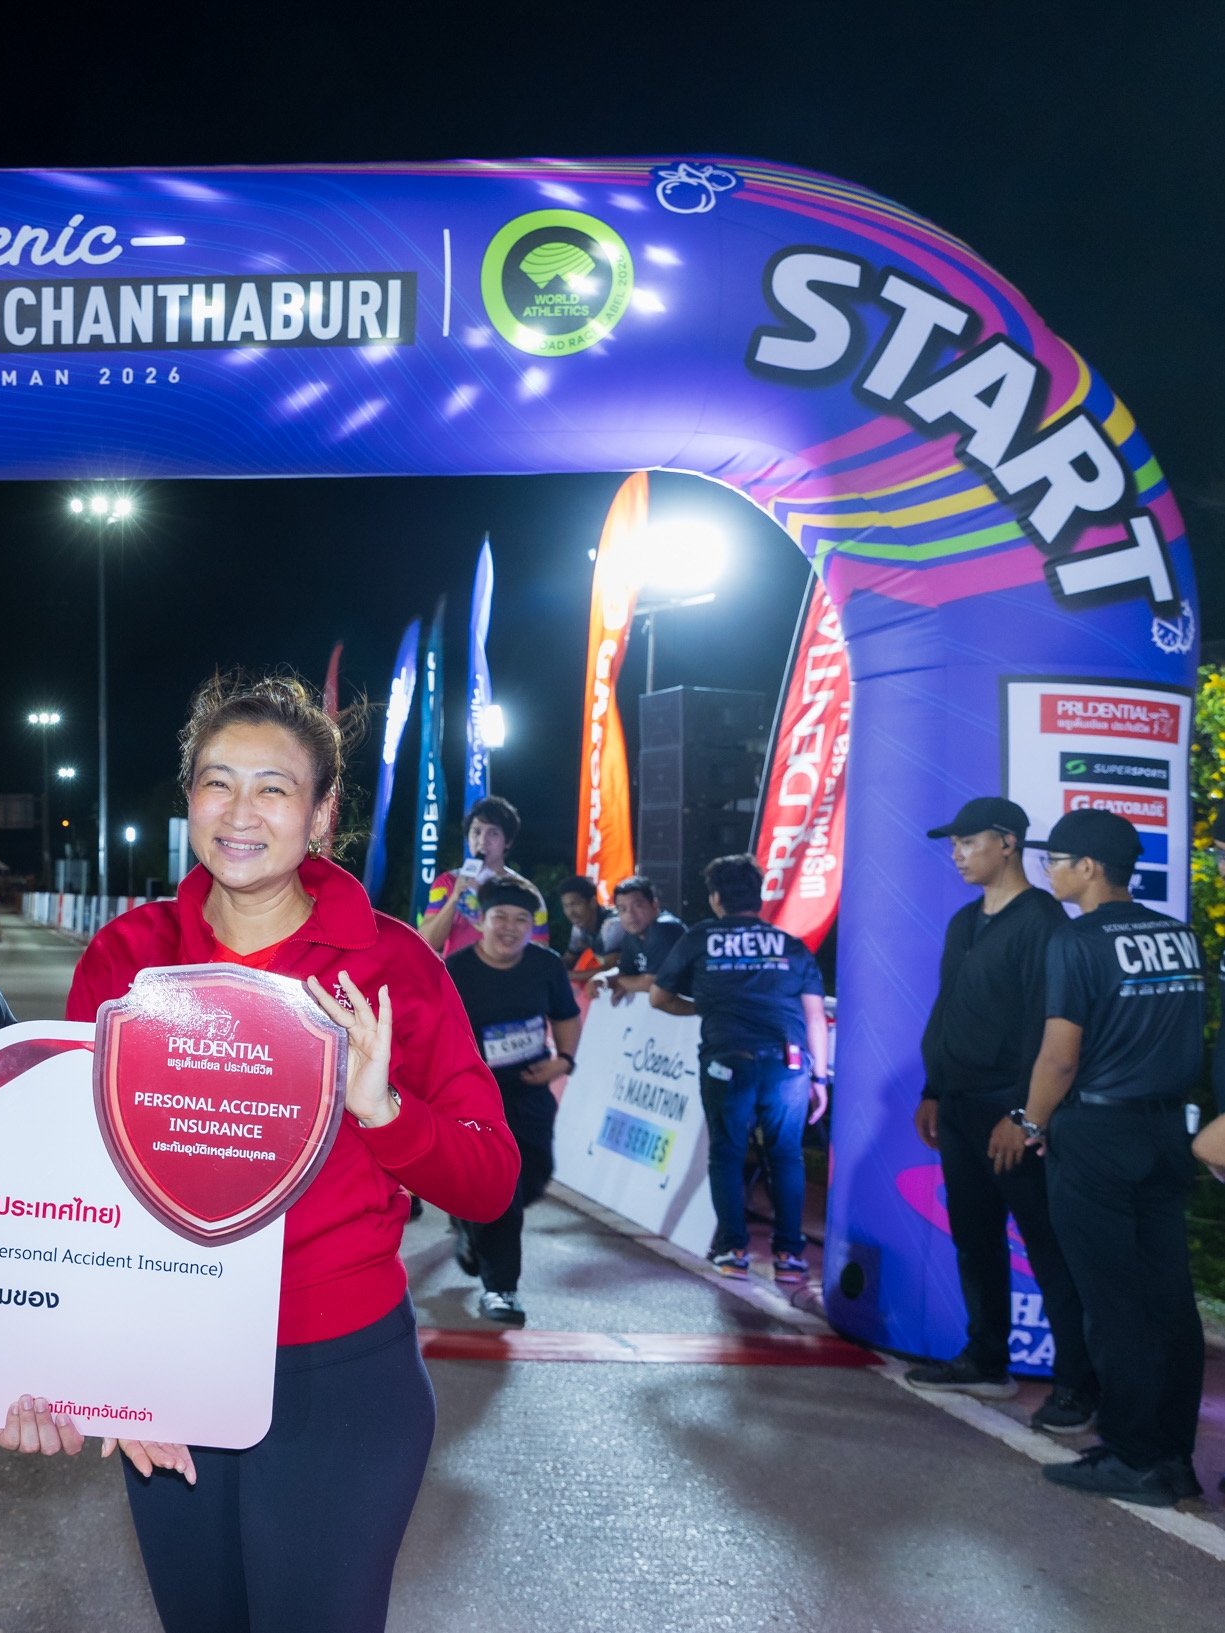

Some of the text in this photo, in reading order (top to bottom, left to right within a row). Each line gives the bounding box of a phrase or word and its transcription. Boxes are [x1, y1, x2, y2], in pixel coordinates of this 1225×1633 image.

[523, 305, 590, 317] ATHLETICS
[534, 294, 579, 304] WORLD
[3, 277, 403, 347] CHANTHABURI
[98, 366, 182, 385] 2026
[755, 253, 1173, 601] START
[1057, 700, 1149, 722] PRUDENTIAL
[1093, 763, 1168, 780] SUPERSPORTS
[707, 932, 785, 957] CREW
[1115, 931, 1201, 974] CREW
[168, 1037, 273, 1061] PRUDENTIAL
[633, 1038, 683, 1080] Scenic
[167, 1057, 273, 1075] พรูเด็นเชียล ประกันชีวิต
[134, 1092, 301, 1119] PERSONAL ACCIDENT
[625, 1077, 689, 1122] MARATHON
[169, 1118, 263, 1139] INSURANCE
[601, 1115, 669, 1163] THE SERIES
[152, 1141, 276, 1162] ประกันอุบัติเหตุส่วนบุคคล
[61, 1247, 132, 1270] Accident
[138, 1253, 223, 1278] Insurance)
